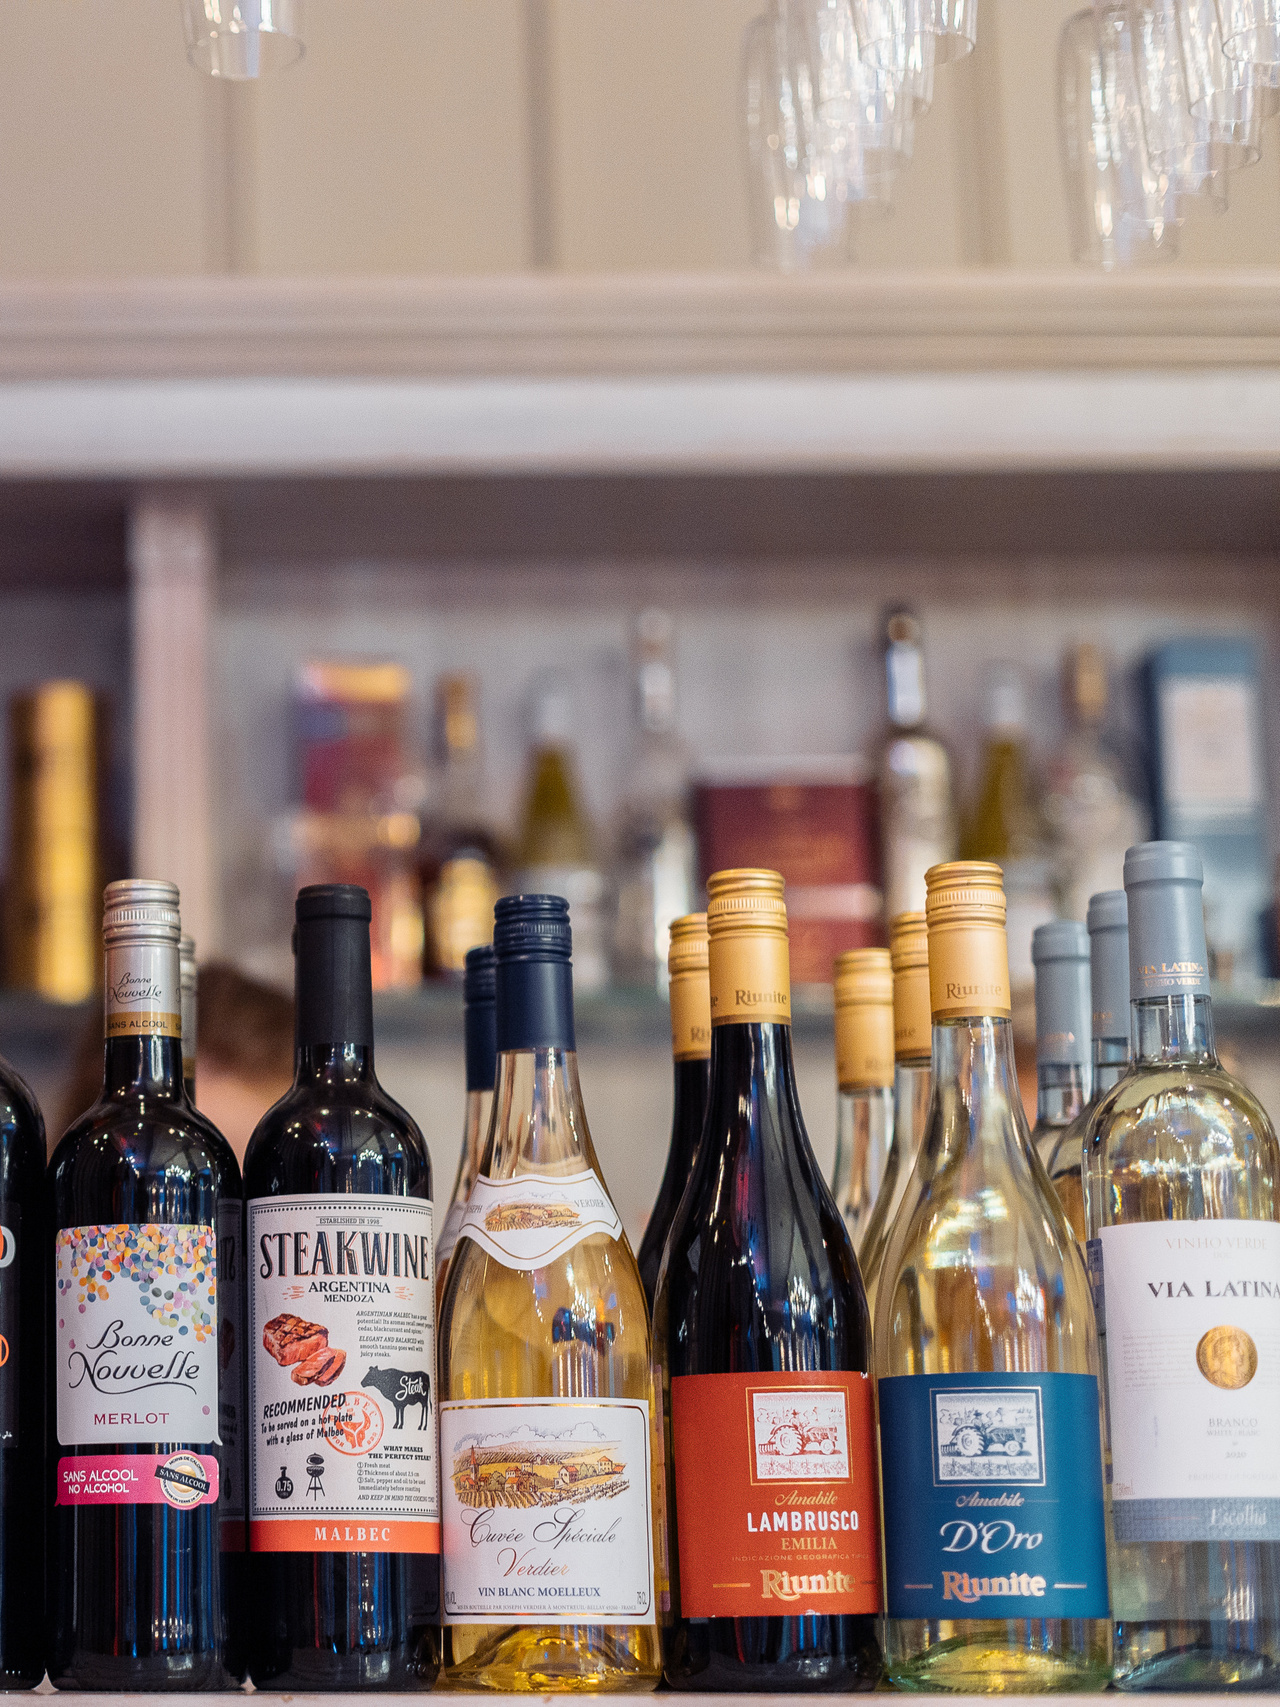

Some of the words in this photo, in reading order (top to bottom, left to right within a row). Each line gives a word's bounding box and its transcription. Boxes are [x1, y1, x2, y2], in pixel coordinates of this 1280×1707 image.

[1161, 962, 1204, 973] LATINA
[116, 972, 152, 986] Bonne
[1176, 977, 1202, 986] VERDE
[108, 984, 162, 1004] Nouvelle
[735, 989, 787, 1006] Riunite
[946, 983, 1002, 999] Riunite
[129, 1020, 168, 1029] ALCOOL
[574, 1199, 606, 1209] VERDIER
[319, 1217, 358, 1225] ESTABLISHED
[358, 1217, 366, 1225] IN
[366, 1218, 380, 1226] 1998
[1165, 1238, 1222, 1250] VINHO
[1225, 1238, 1268, 1250] VERDE
[259, 1230, 430, 1281] STEAKWINE
[308, 1281, 391, 1294] ARGENTINA
[1147, 1281, 1195, 1298] VIA
[1204, 1280, 1280, 1299] LATINA
[323, 1294, 375, 1303] MENDOZA
[356, 1310, 393, 1318] ARGENTINIAN
[393, 1311, 411, 1319] MALBEC
[86, 1319, 174, 1350] Bonne
[383, 1335, 395, 1343] AND
[68, 1350, 200, 1394] Nouvelle
[395, 1375, 427, 1401] Steak
[263, 1393, 346, 1419] RECOMMENDED
[93, 1412, 170, 1426] MERLOT
[260, 1422, 267, 1434] To
[268, 1421, 276, 1432] be
[276, 1417, 298, 1430] served
[300, 1418, 309, 1427] on
[319, 1414, 331, 1425] hot
[333, 1412, 353, 1426] plate
[1208, 1417, 1258, 1428] BRANCO
[266, 1434, 279, 1446] with
[286, 1432, 304, 1446] glass
[306, 1429, 315, 1439] of
[316, 1426, 345, 1439] Malbec
[63, 1470, 87, 1483] SANS
[89, 1468, 139, 1482] ALCOOL
[159, 1468, 180, 1481] SANS
[180, 1475, 207, 1491] ALCOOL
[68, 1484, 81, 1494] NO
[83, 1482, 130, 1494] ALCOHOL
[276, 1480, 292, 1492] 0.75
[774, 1490, 838, 1506] Amabile
[955, 1491, 1025, 1508] Amabile
[460, 1508, 526, 1548] Cuvée
[532, 1507, 623, 1550] Spéciale
[746, 1510, 859, 1533] LAMBRUSCO
[314, 1526, 391, 1542] MALBEC
[939, 1520, 1043, 1555] D'Oro
[781, 1537, 838, 1551] EMILIA
[496, 1546, 571, 1578] Verdier
[731, 1554, 793, 1562] INDICAZIONE
[795, 1553, 850, 1561] GEOGRAFICA
[478, 1587, 496, 1597] VIN
[498, 1587, 535, 1597] BLANC
[537, 1587, 601, 1598] MOELLEUX
[760, 1569, 856, 1602] Riunite
[942, 1570, 1047, 1604] Riunite
